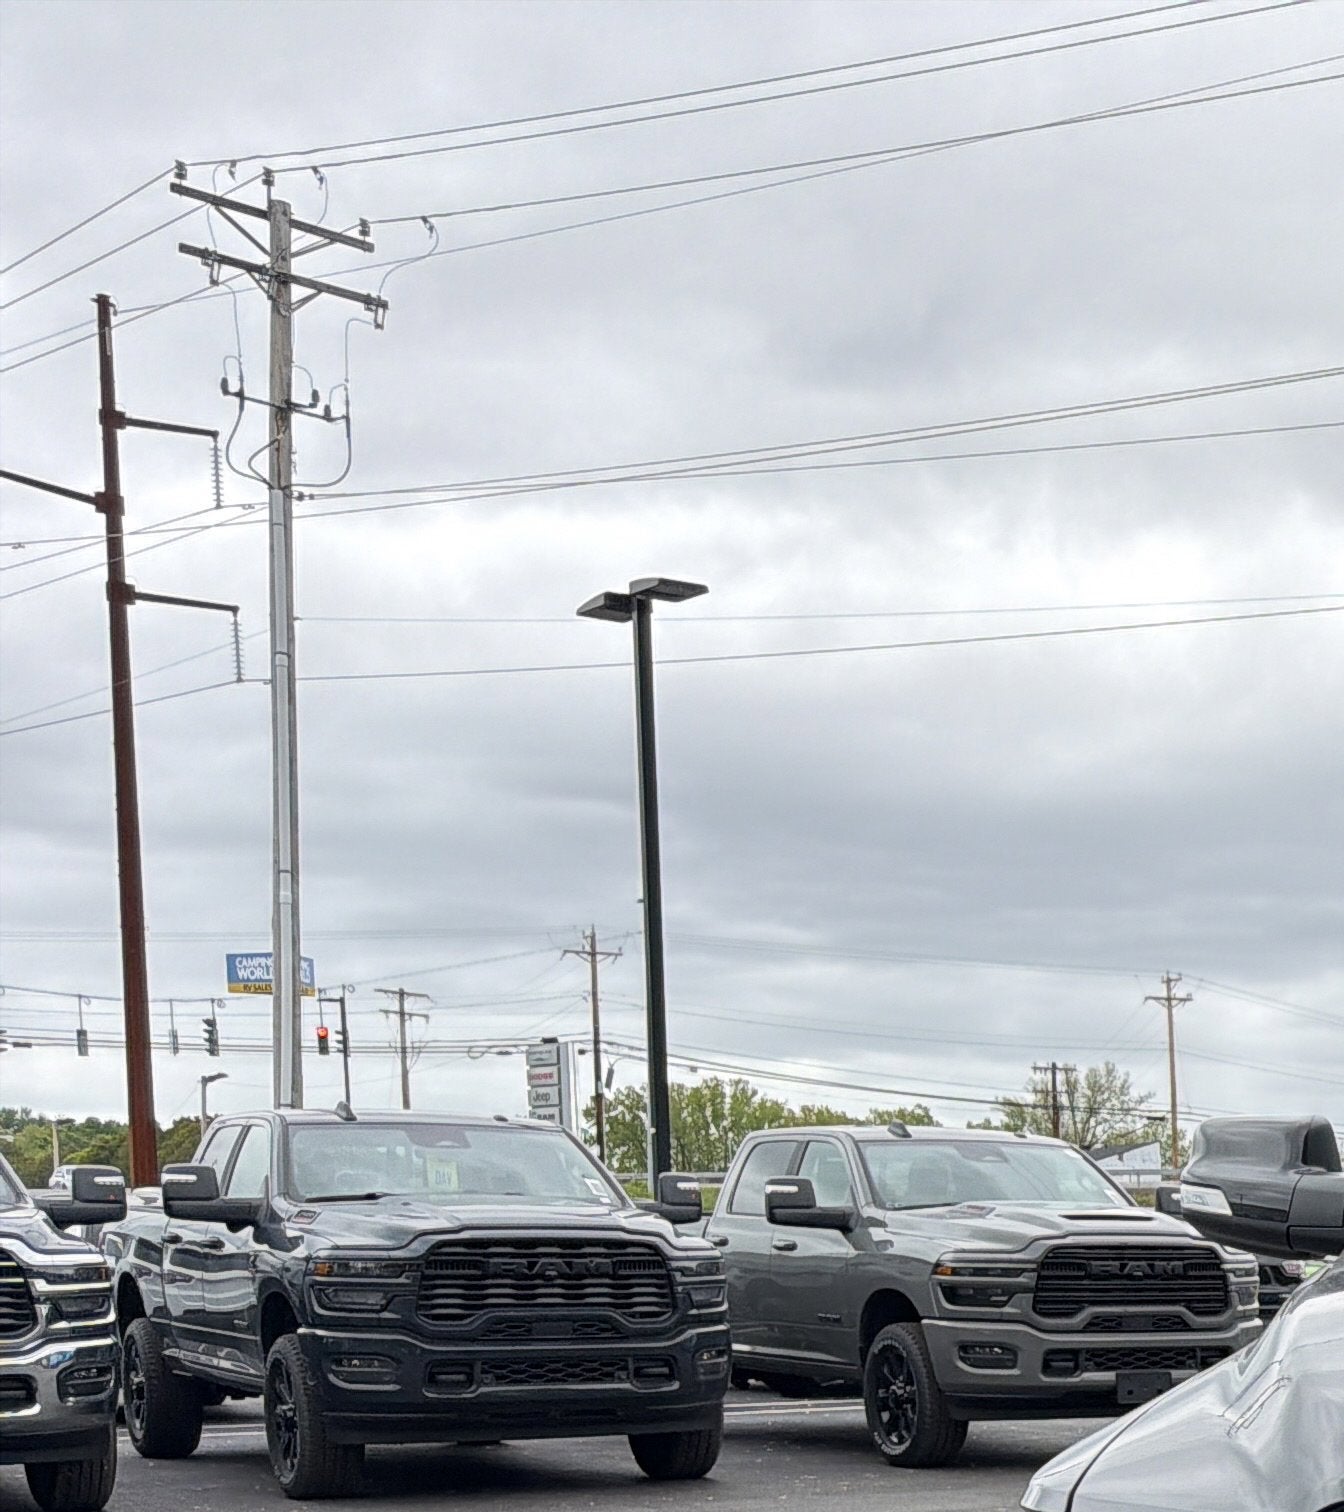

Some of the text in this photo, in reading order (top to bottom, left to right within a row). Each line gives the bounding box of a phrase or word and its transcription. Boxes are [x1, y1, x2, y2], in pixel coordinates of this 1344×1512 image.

[235, 956, 273, 968] CAMPIN
[533, 1090, 551, 1103] Jeep
[488, 1257, 612, 1276] RAM
[1089, 1261, 1184, 1276] RAM
